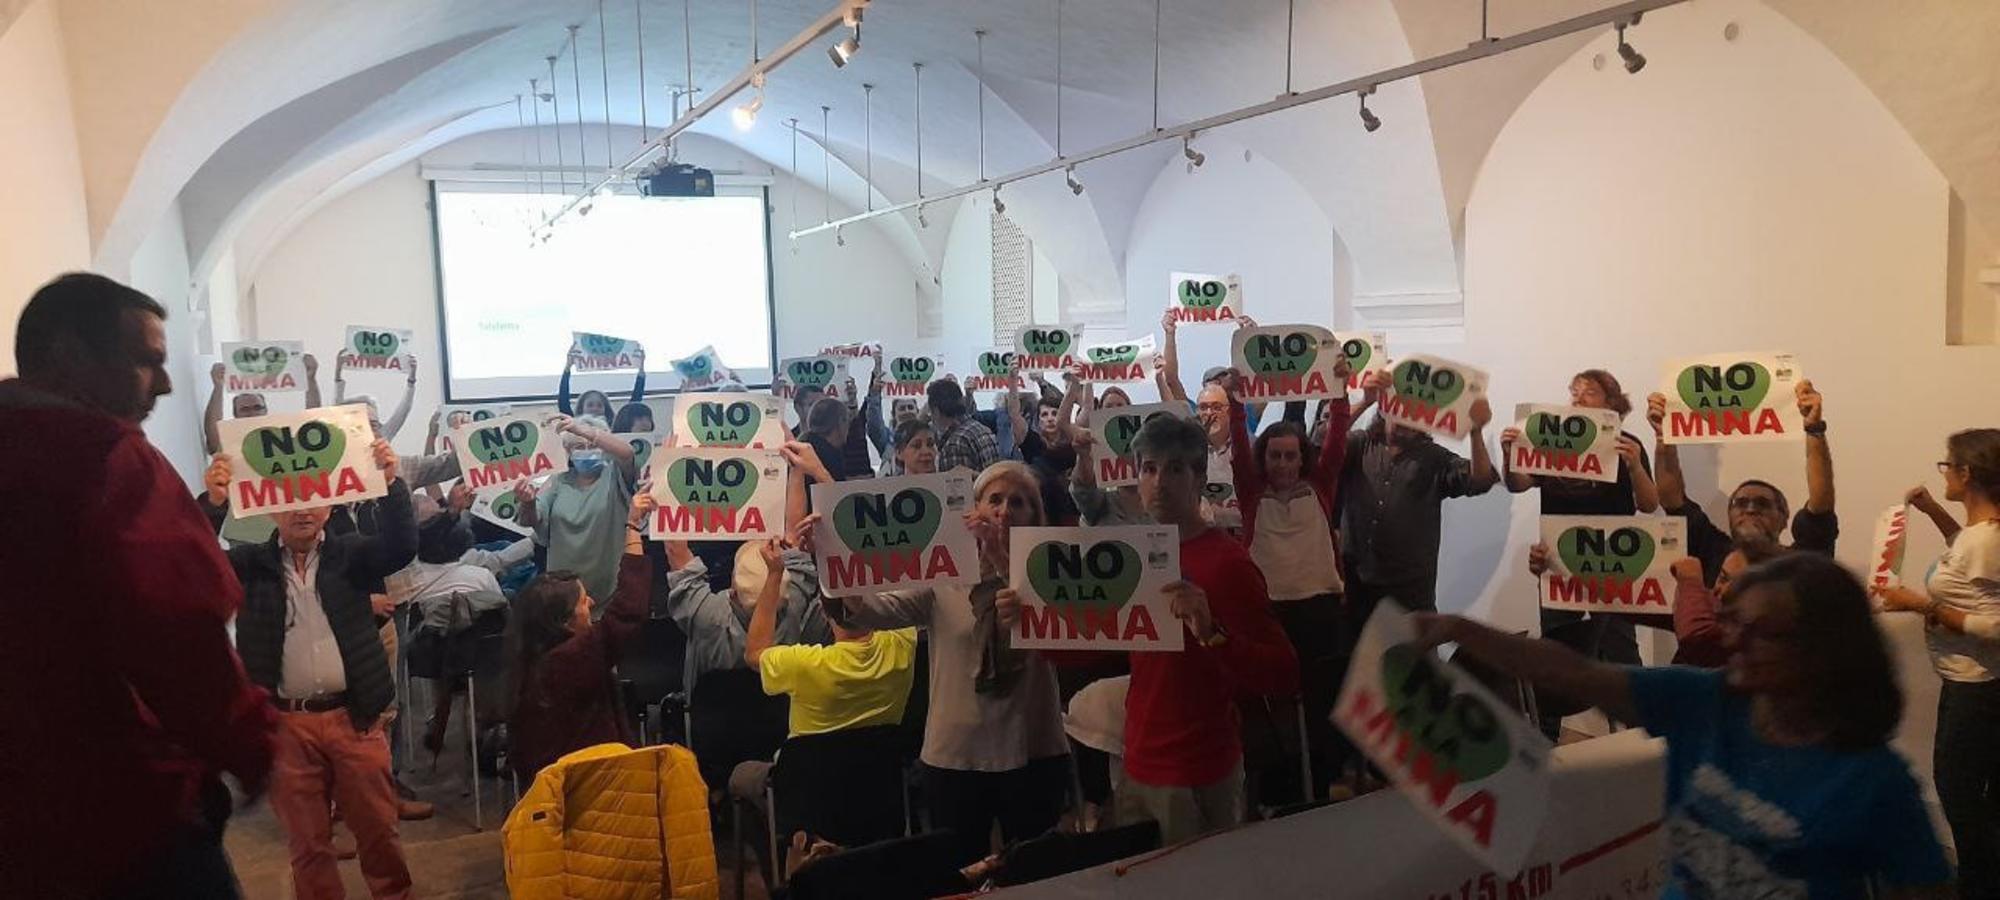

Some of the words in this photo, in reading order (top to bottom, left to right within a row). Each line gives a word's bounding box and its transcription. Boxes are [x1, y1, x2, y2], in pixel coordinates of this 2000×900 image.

[1186, 280, 1218, 297] NO
[1173, 306, 1235, 322] MINA
[362, 332, 392, 346] NO
[1032, 329, 1064, 344] NO
[1257, 333, 1307, 358] NO
[243, 347, 279, 363] NO
[1096, 345, 1132, 357] NO
[1343, 340, 1363, 358] O
[344, 354, 401, 370] MINA
[578, 353, 632, 369] MINA
[797, 360, 827, 374] NO
[900, 357, 928, 372] NO
[1018, 354, 1073, 369] MINA
[1262, 362, 1272, 372] A
[1277, 360, 1296, 371] LA
[1080, 362, 1145, 380] MINA
[1406, 361, 1455, 390] NO
[1694, 364, 1756, 392] NO
[230, 373, 295, 390] MINA
[887, 382, 925, 396] MIN
[1238, 371, 1328, 398] MINA
[783, 384, 839, 399] MA
[1700, 396, 1710, 408] A
[1718, 395, 1741, 407] LA
[701, 402, 750, 427] NO
[1378, 392, 1457, 433] MINA
[1118, 415, 1141, 439] N
[1539, 414, 1586, 438] NO
[1671, 408, 1784, 437] MINA
[261, 421, 331, 458] NO
[480, 422, 527, 450] NO
[706, 431, 715, 441] A
[720, 430, 738, 441] LA
[1541, 439, 1549, 447] A
[1555, 439, 1572, 448] LA
[490, 452, 498, 461] A
[503, 446, 521, 458] LA
[1516, 447, 1602, 474] MINA
[271, 462, 284, 474] A
[292, 457, 318, 471] LA
[469, 452, 553, 488] MINA
[685, 457, 746, 487] NO
[1100, 457, 1137, 482] MI
[238, 466, 366, 509] MINA
[688, 491, 700, 502] A
[707, 491, 729, 502] LA
[854, 490, 926, 529] NO
[657, 506, 766, 533] MINA
[862, 534, 875, 548] A
[883, 531, 910, 547] LA
[1575, 528, 1641, 557] NO
[827, 544, 959, 590] MINA
[1048, 543, 1124, 580] NO
[1580, 561, 1592, 572] A
[1600, 561, 1625, 573] LA
[1055, 586, 1069, 600] A
[1078, 586, 1107, 600] LA
[1549, 574, 1667, 606] MINA
[1021, 604, 1159, 641] MINA
[1351, 689, 1497, 849] MINA
